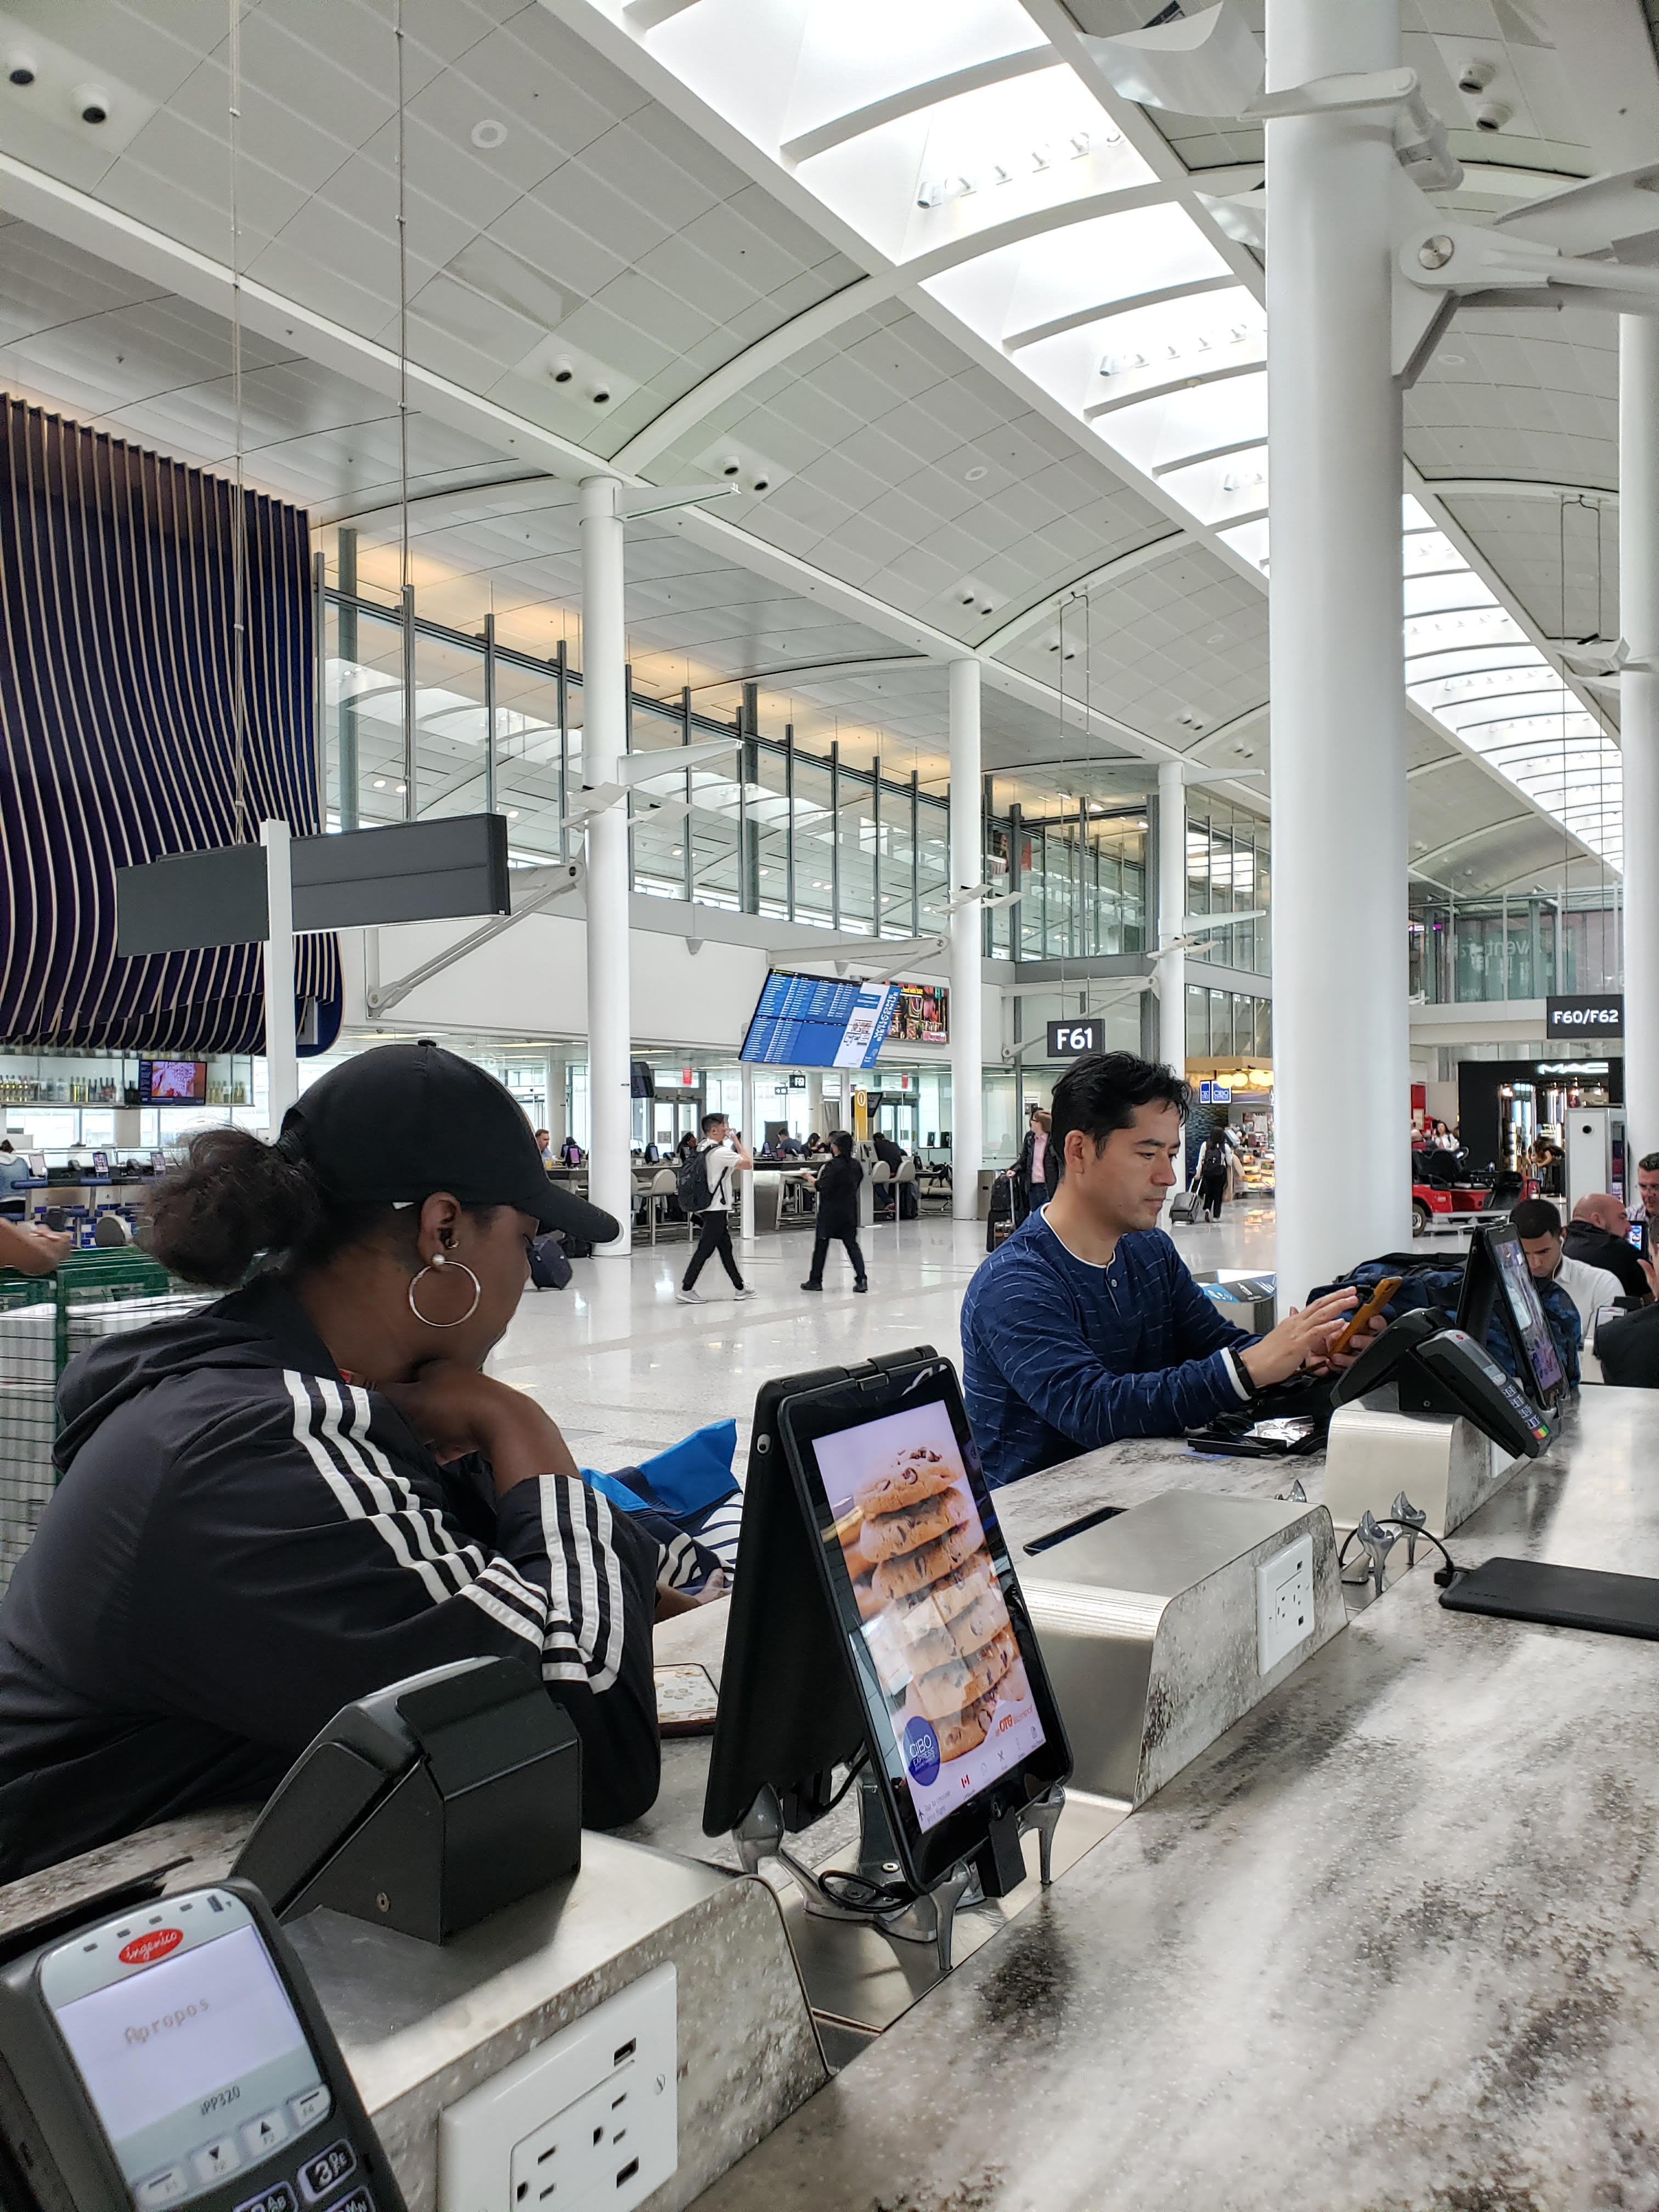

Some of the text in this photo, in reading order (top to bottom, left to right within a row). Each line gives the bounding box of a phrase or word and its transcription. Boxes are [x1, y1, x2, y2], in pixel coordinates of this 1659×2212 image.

[874, 994, 893, 1039] WELCOME
[877, 991, 899, 1041] BIENVENUE
[1553, 1008, 1618, 1025] F60/F62
[1057, 1027, 1092, 1050] F61
[794, 1076, 805, 1086] F61
[910, 1734, 932, 1757] CIBO
[912, 1746, 935, 1767] EXPRESS
[125, 1997, 210, 2045] Apropos
[200, 2086, 240, 2116] iPP320
[315, 2160, 332, 2186] 3
